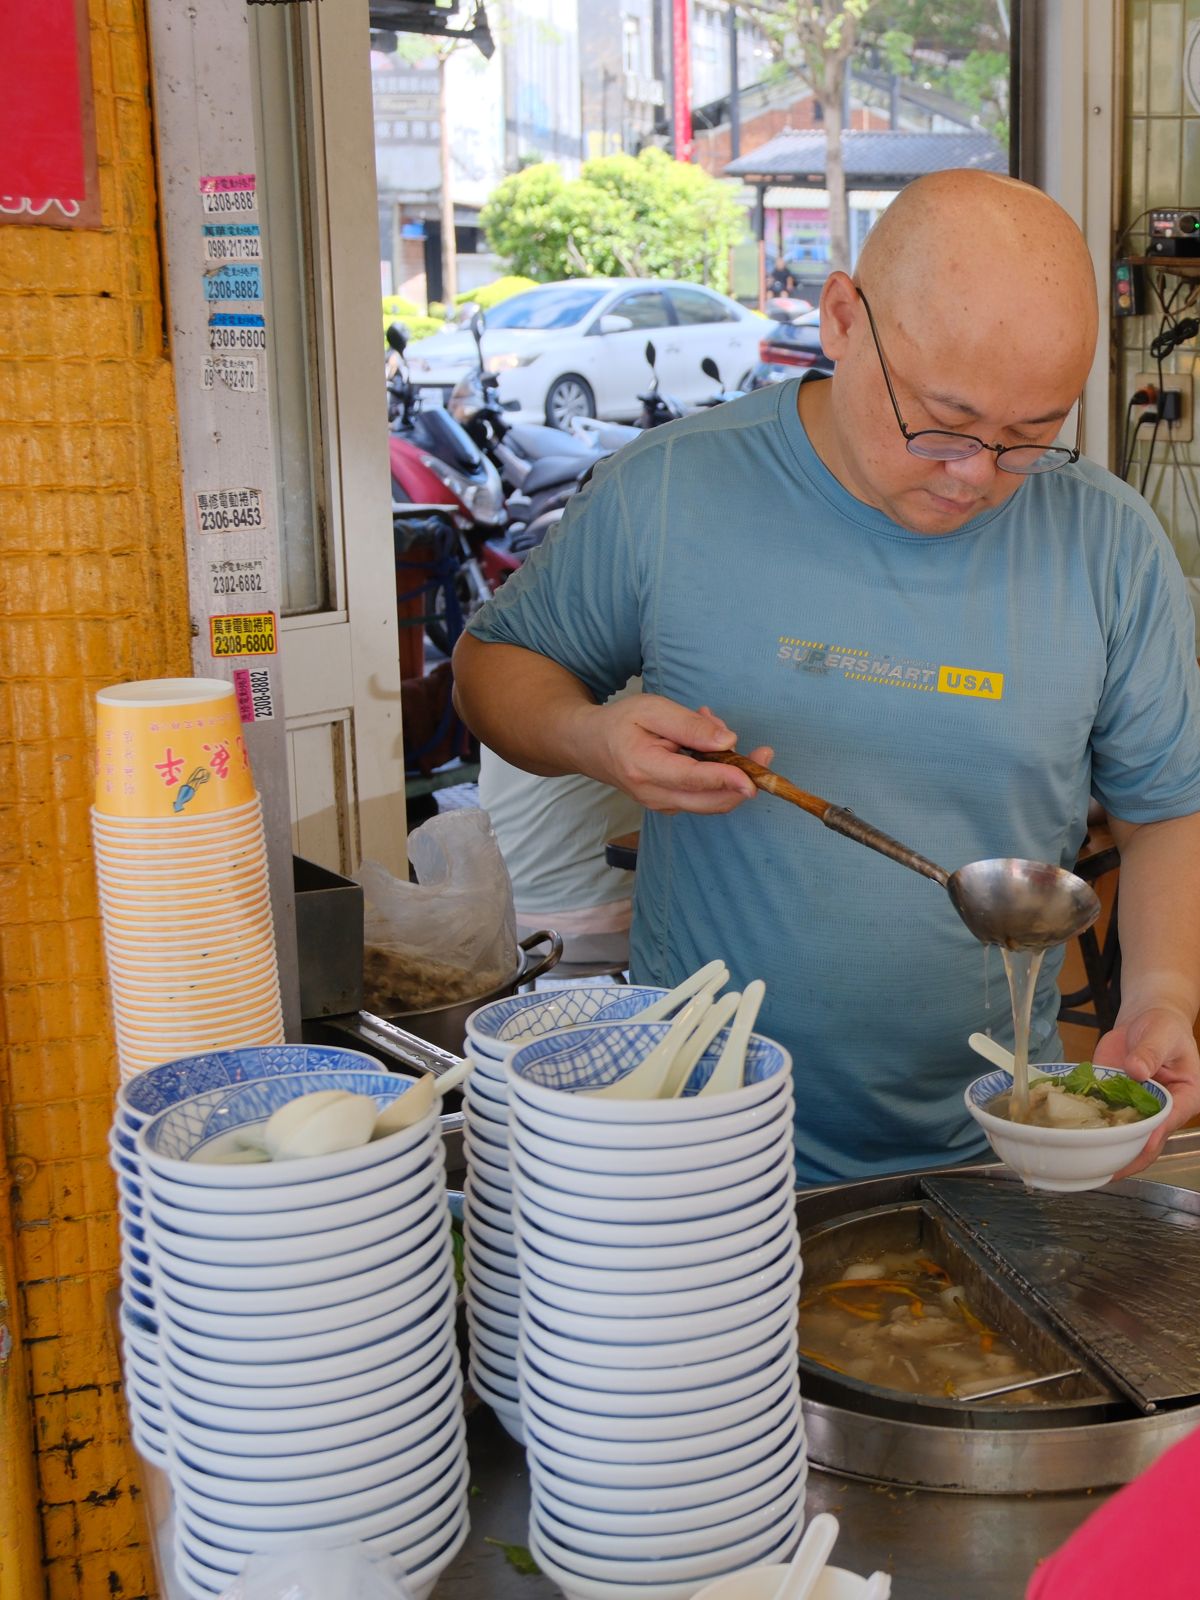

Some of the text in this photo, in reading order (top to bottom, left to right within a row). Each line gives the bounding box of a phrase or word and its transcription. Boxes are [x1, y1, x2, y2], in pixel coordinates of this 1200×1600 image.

[207, 280, 259, 299] 2308-8882
[210, 329, 266, 349] 2308-6800
[201, 507, 262, 530] 2306-8453
[213, 574, 262, 594] 2302-6882
[215, 634, 275, 655] 2308-6800
[777, 645, 937, 684] SUPERSMART
[946, 671, 994, 693] USA
[250, 671, 273, 717] 2308-8882
